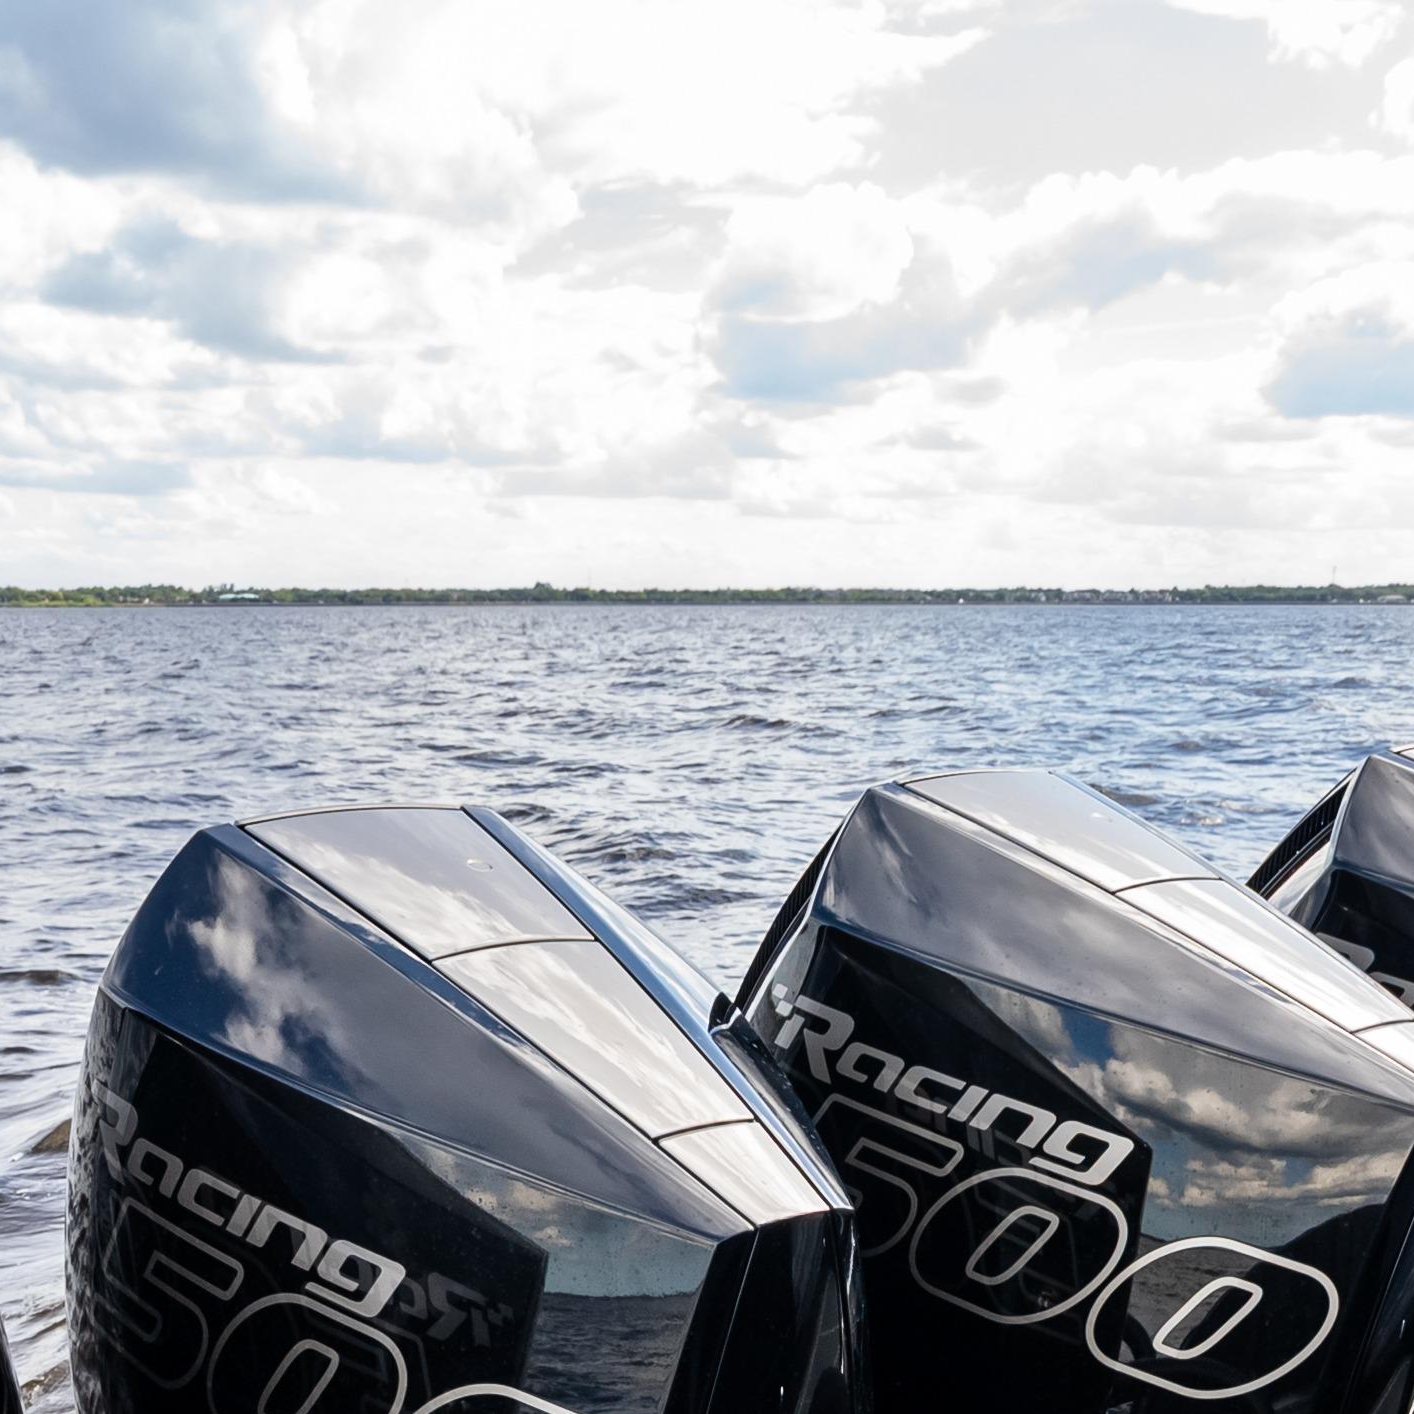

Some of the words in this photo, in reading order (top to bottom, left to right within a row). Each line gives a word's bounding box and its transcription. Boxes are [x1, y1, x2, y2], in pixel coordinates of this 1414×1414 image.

[87, 1078, 407, 1318] Racing
[772, 983, 1135, 1187] Racing
[811, 1093, 1339, 1400] 500
